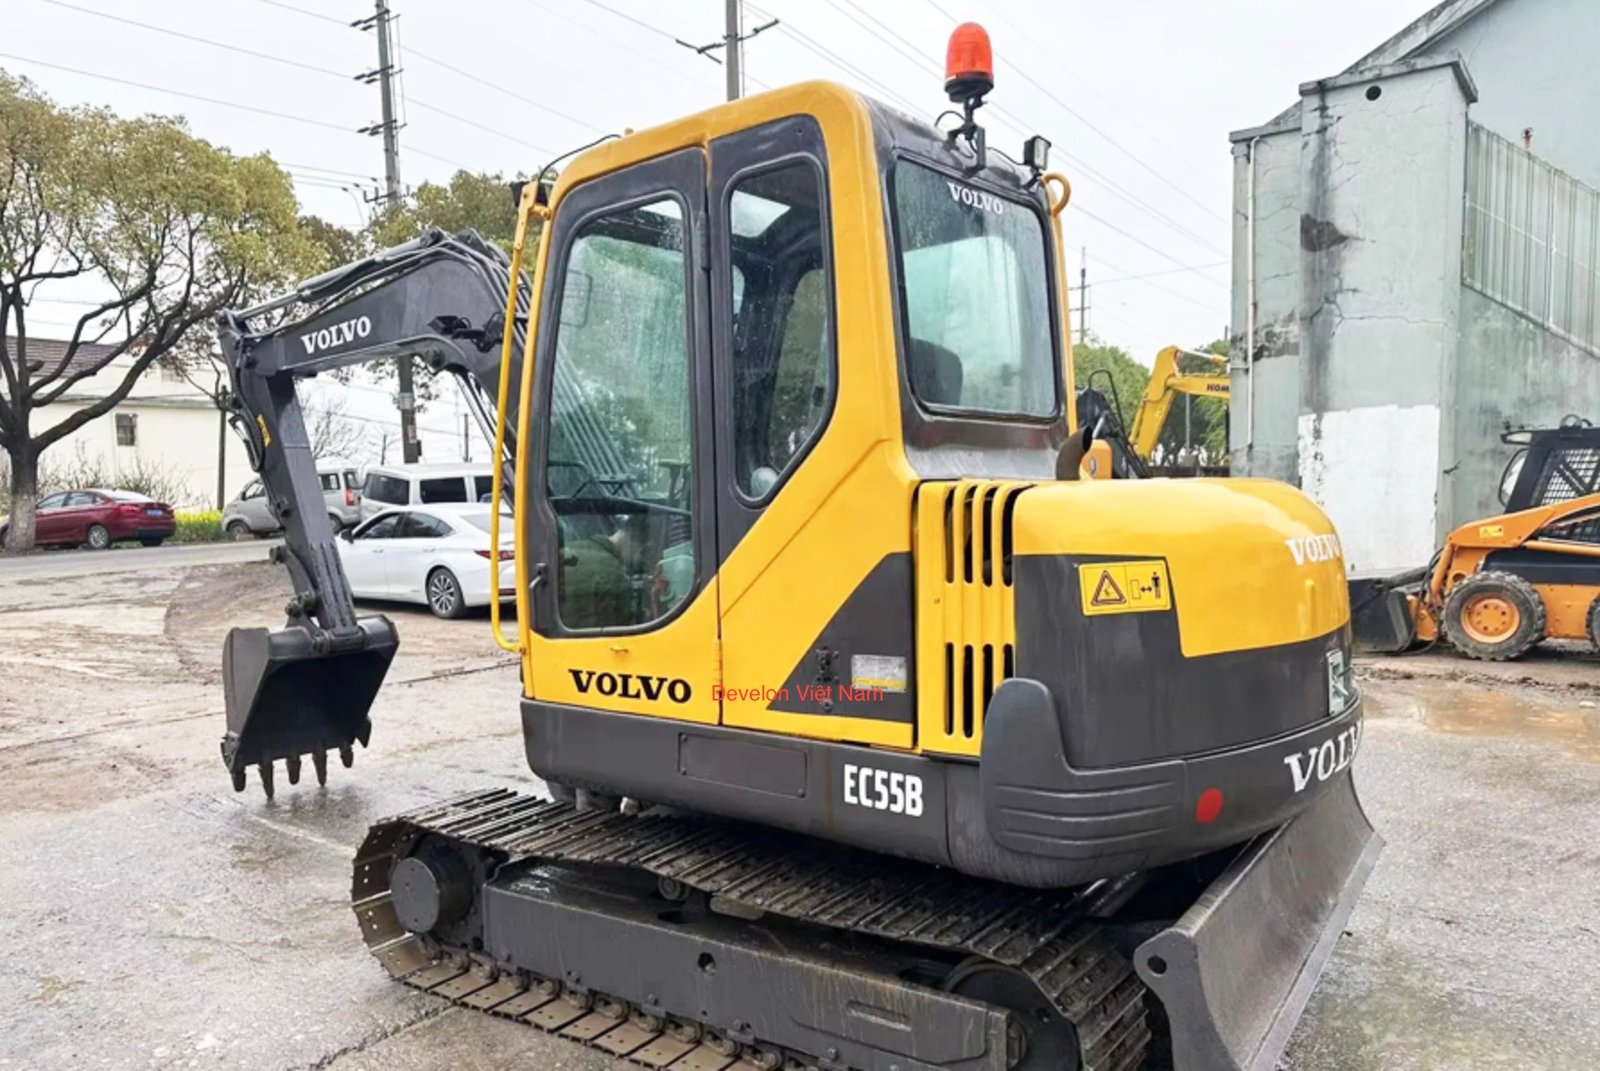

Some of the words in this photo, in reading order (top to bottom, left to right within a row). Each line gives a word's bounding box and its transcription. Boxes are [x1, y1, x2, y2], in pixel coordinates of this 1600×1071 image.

[947, 182, 1003, 215] VOLVO
[301, 316, 372, 354] VOLVO
[568, 668, 692, 704] VOLVO
[844, 763, 924, 817] EC55B
